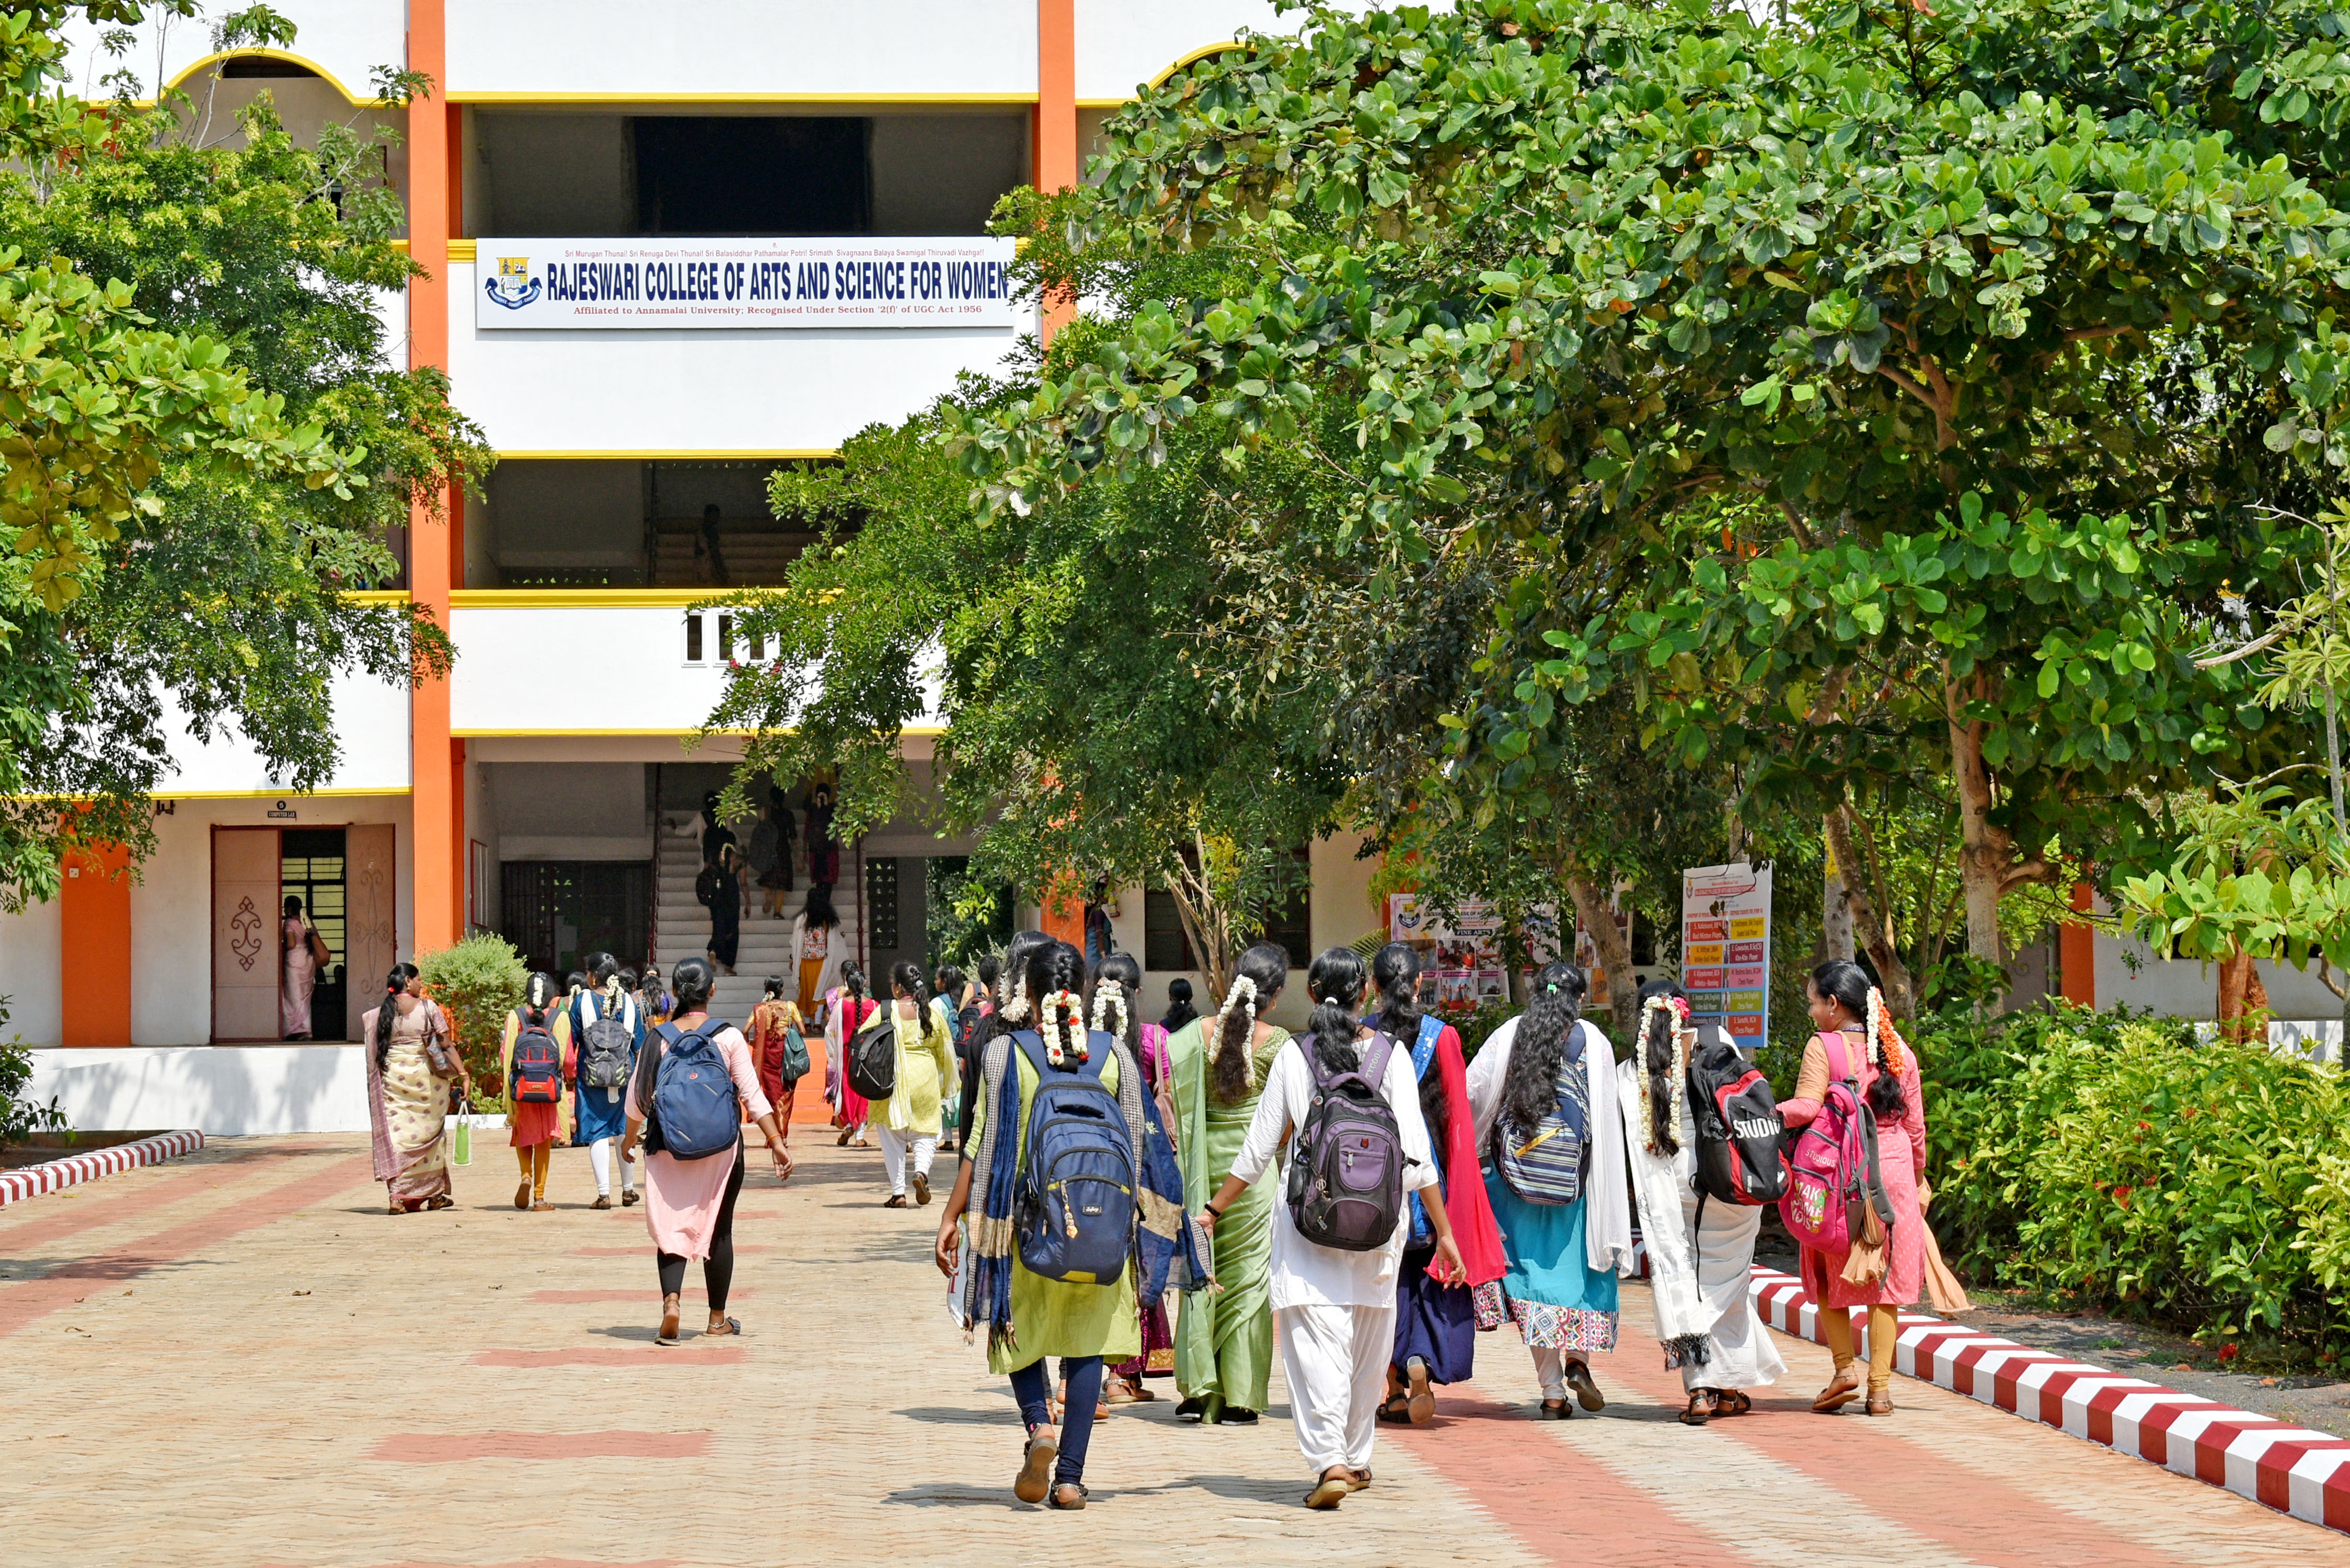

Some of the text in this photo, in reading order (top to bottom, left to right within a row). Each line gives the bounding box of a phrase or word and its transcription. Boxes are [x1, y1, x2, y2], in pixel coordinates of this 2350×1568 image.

[575, 250, 603, 259] Murugan
[640, 250, 663, 259] Renuga
[836, 249, 872, 258] Sivagnaana
[958, 249, 984, 257] Vazhga!!
[548, 261, 1007, 301] RAJESWARI COLLEGE OF ARTS AND SCIENCE FOR WOMEN
[691, 306, 744, 316] University;
[747, 306, 802, 316] Recognised
[1365, 1048, 1383, 1079] TYCOON
[1805, 1149, 1836, 1167] STUDIOUS
